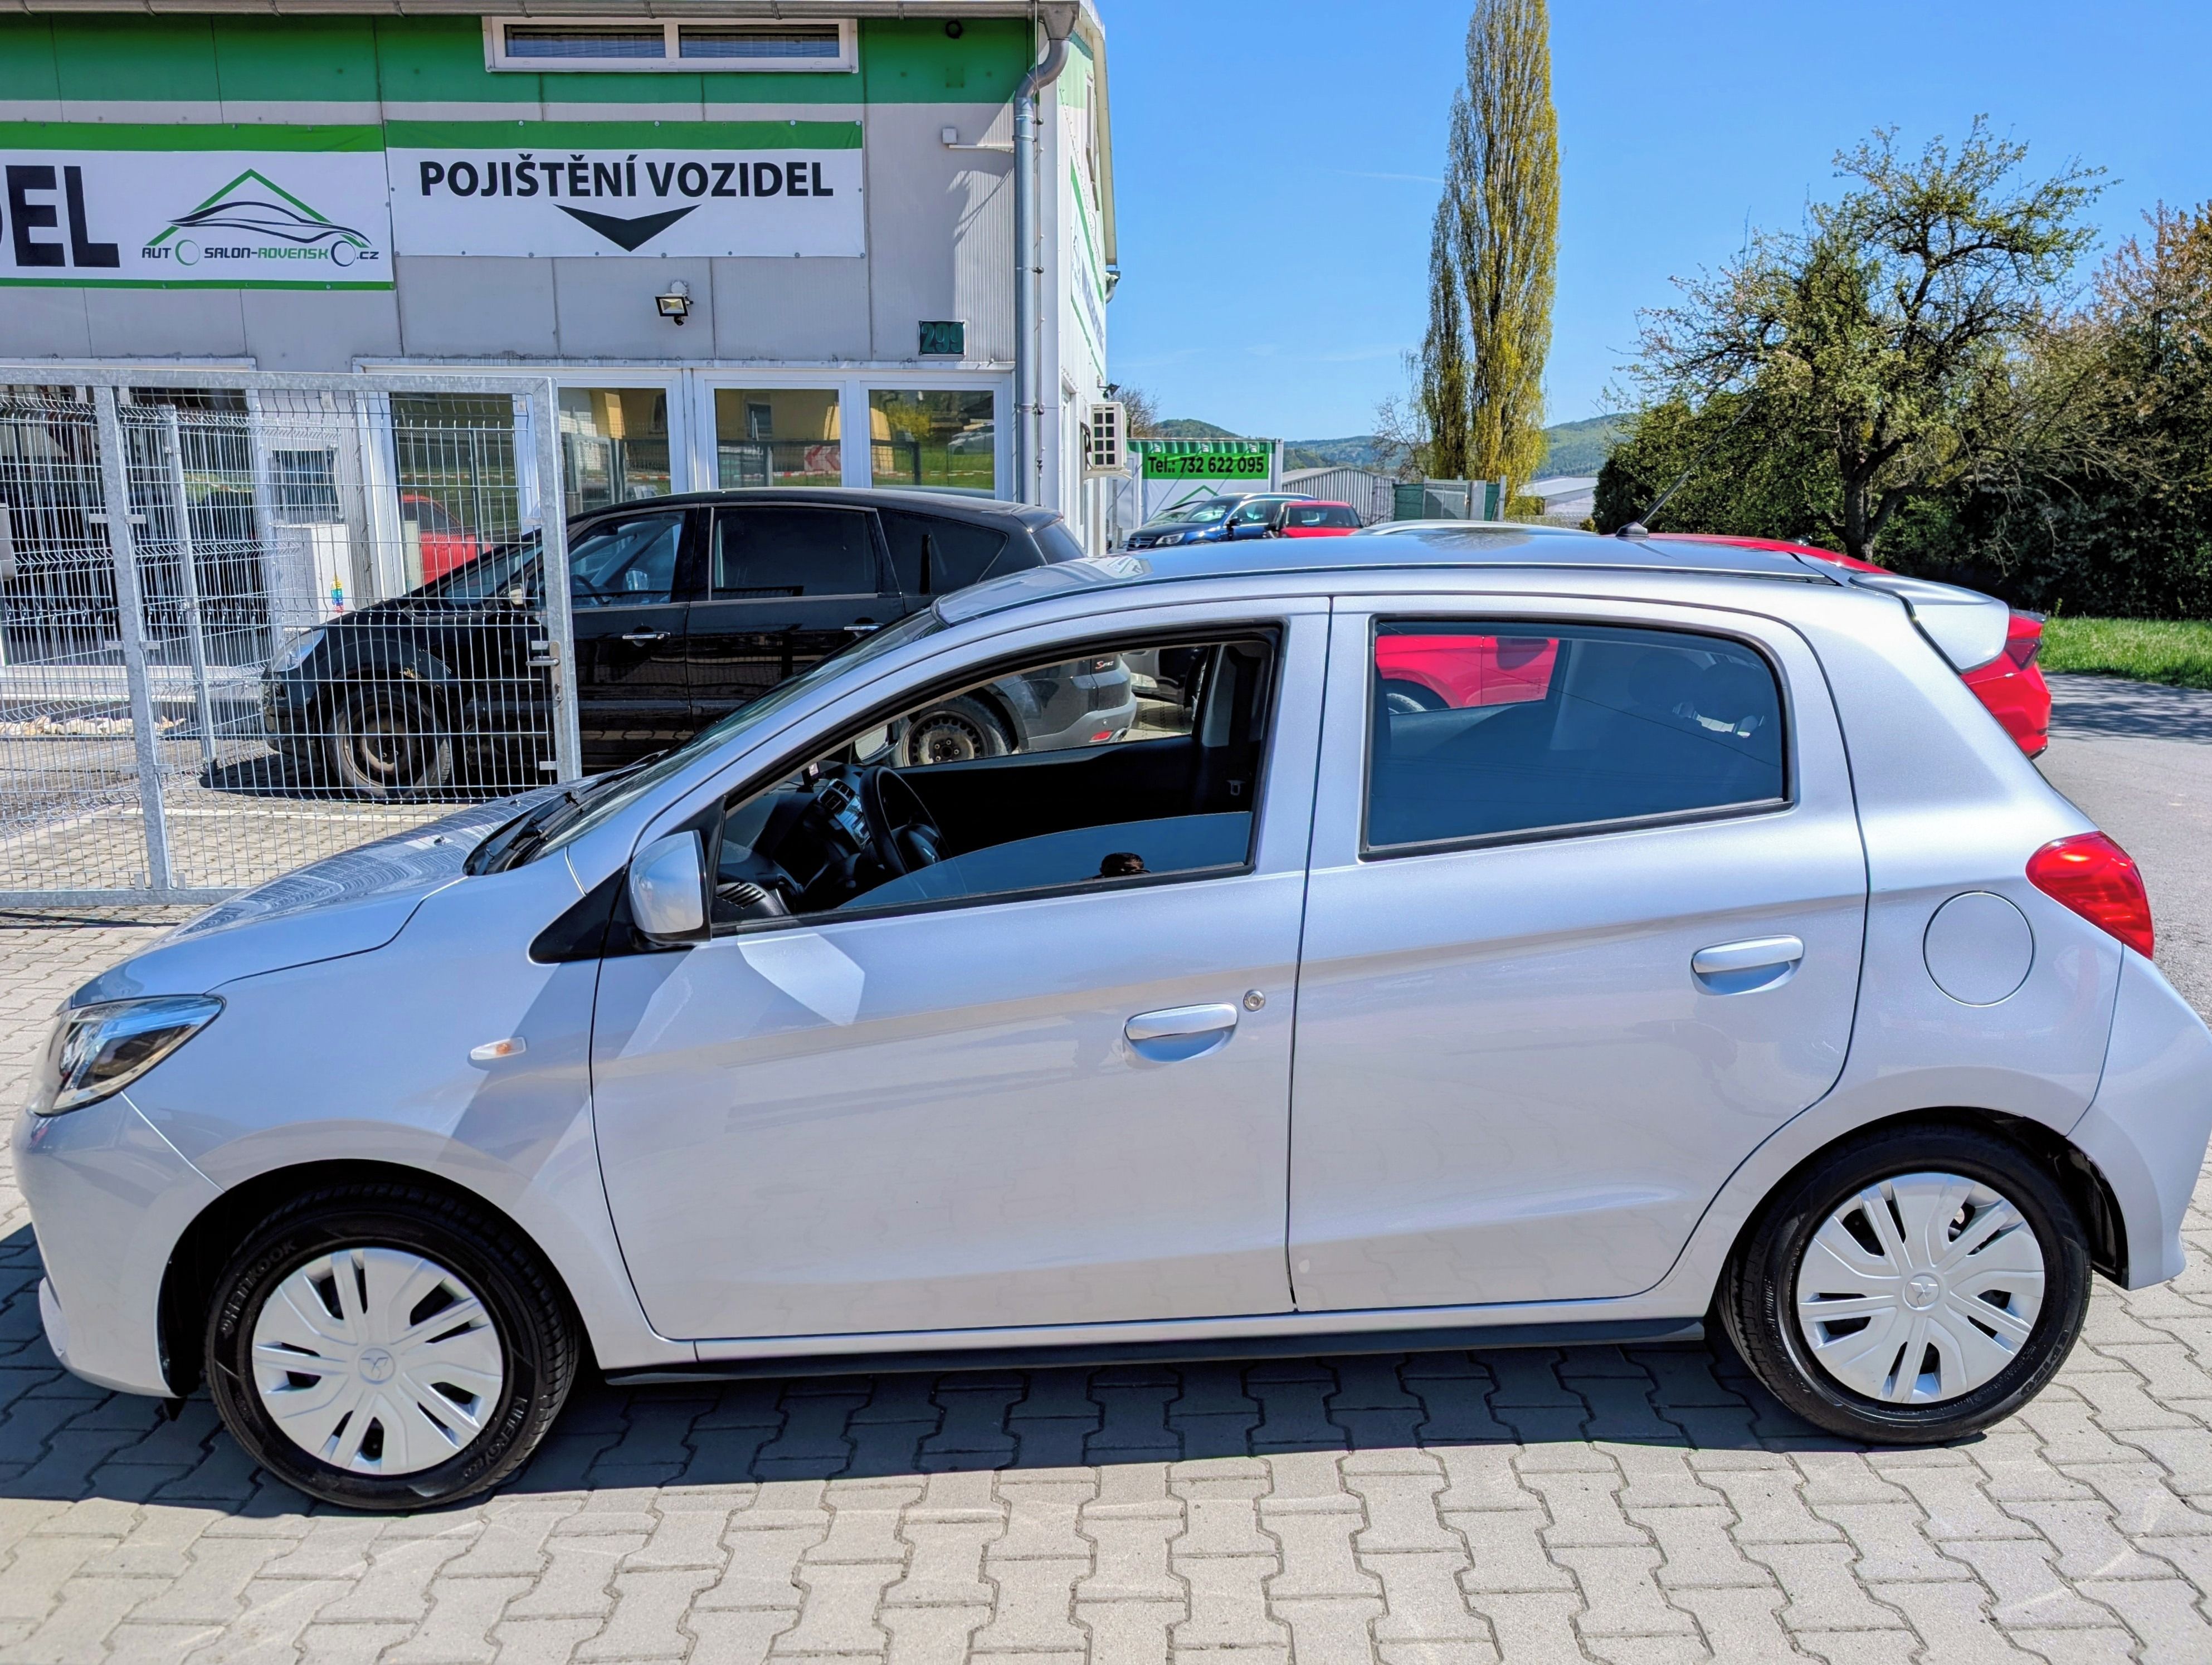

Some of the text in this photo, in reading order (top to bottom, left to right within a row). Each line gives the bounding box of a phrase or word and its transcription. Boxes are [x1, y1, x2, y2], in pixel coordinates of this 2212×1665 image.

[420, 153, 834, 197] POJIŠTĚNÍ VOZIDEL
[0, 165, 120, 268] EL
[921, 323, 964, 353] 299
[1148, 456, 1264, 473] Tel.: 732 622 095
